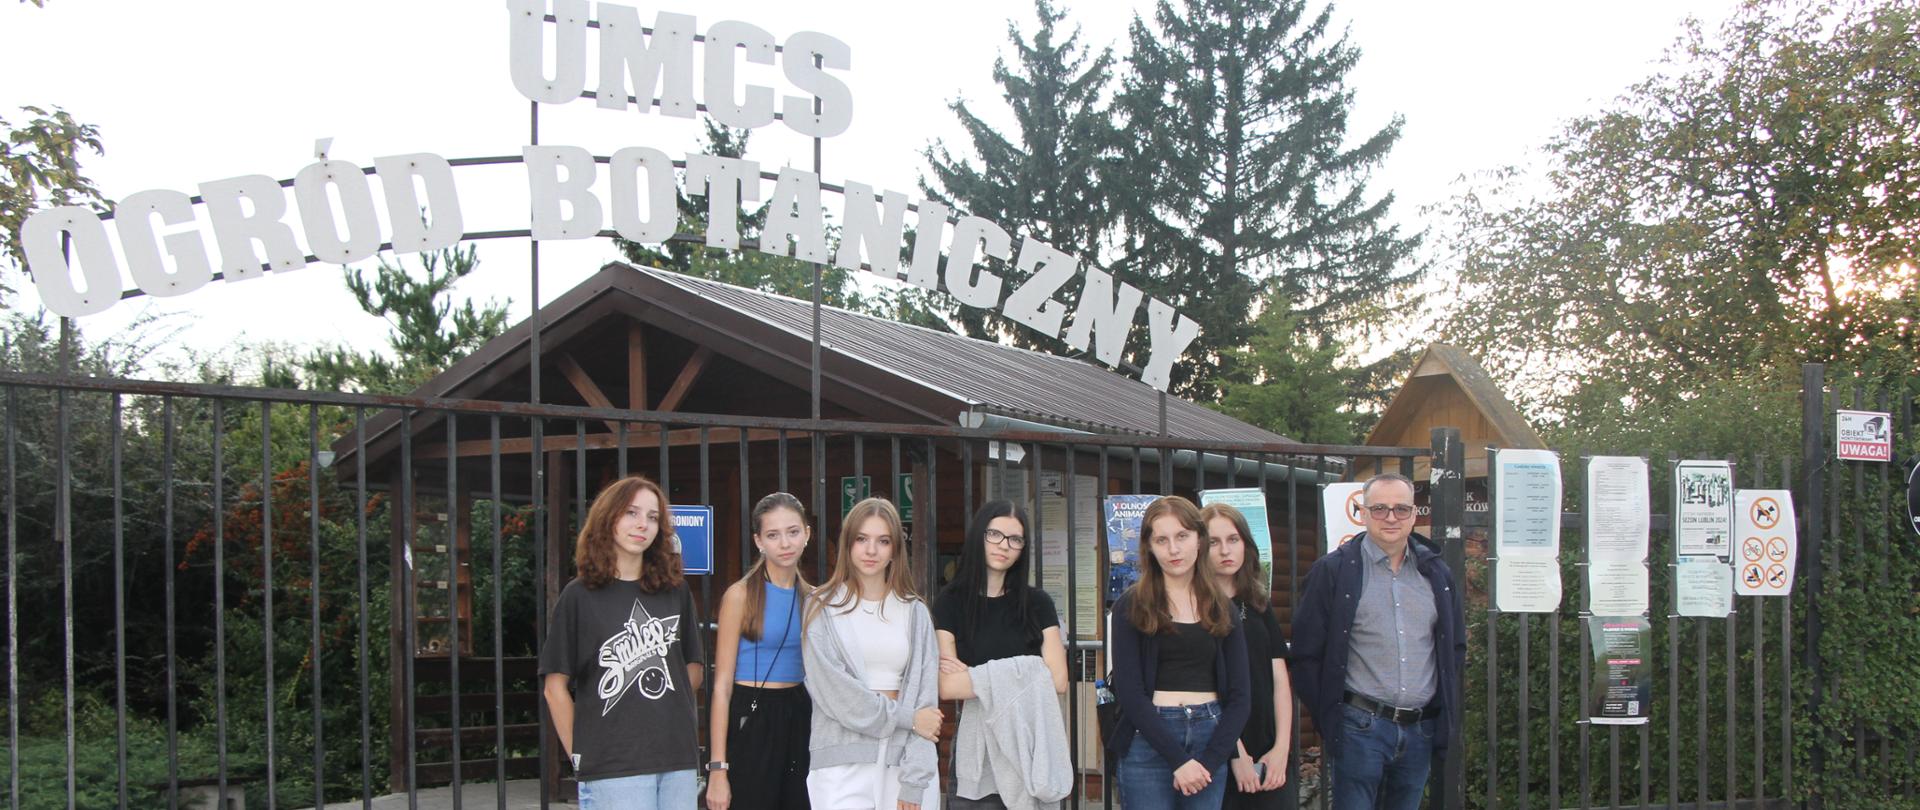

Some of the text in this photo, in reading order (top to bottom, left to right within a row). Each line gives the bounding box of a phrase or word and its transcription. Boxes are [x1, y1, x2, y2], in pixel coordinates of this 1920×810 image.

[507, 0, 853, 137] UMCS
[20, 137, 1200, 393] OGRÓD BOTANICZNY
[1841, 443, 1887, 457] UWAGA!
[670, 515, 704, 527] RONIONY
